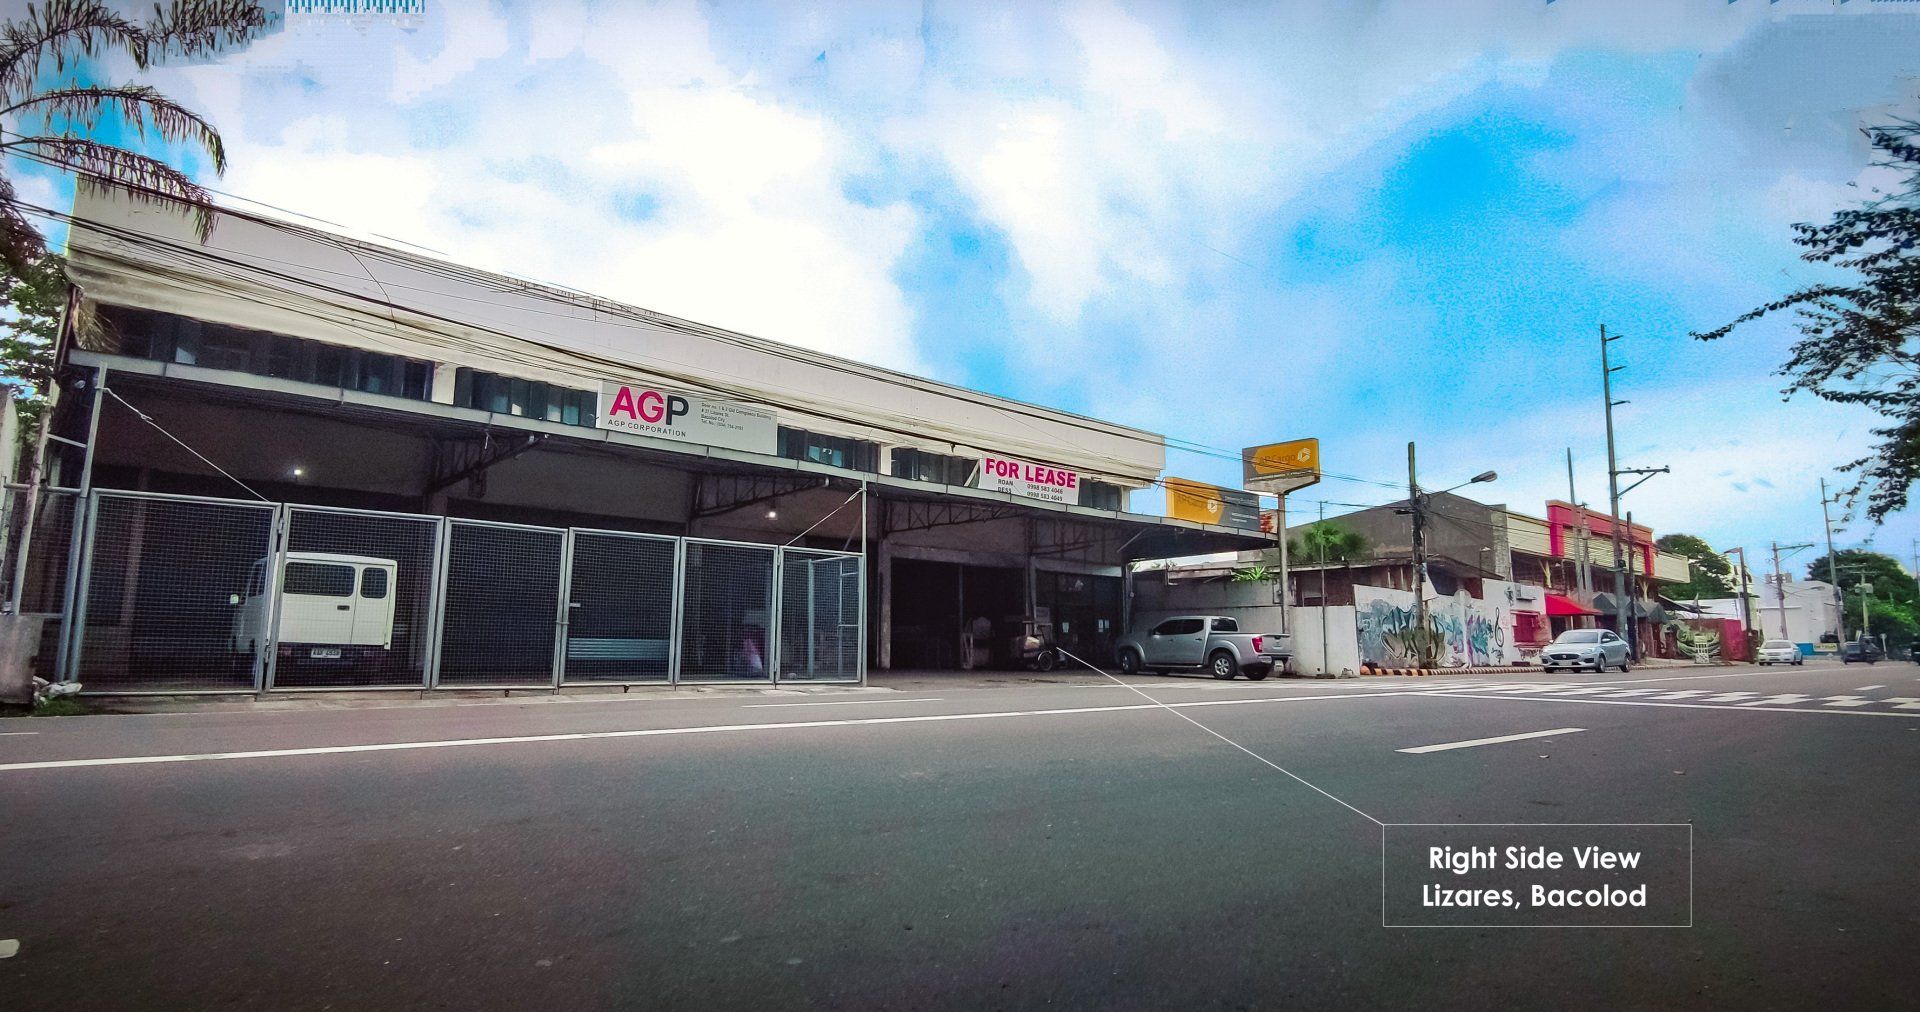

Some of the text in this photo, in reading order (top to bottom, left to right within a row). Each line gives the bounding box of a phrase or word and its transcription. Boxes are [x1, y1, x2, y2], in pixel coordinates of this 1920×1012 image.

[609, 386, 690, 426] AGP
[608, 419, 686, 438] AGP CORPORATION
[985, 457, 1077, 489] FOR LEASE
[998, 479, 1014, 487] ROAN
